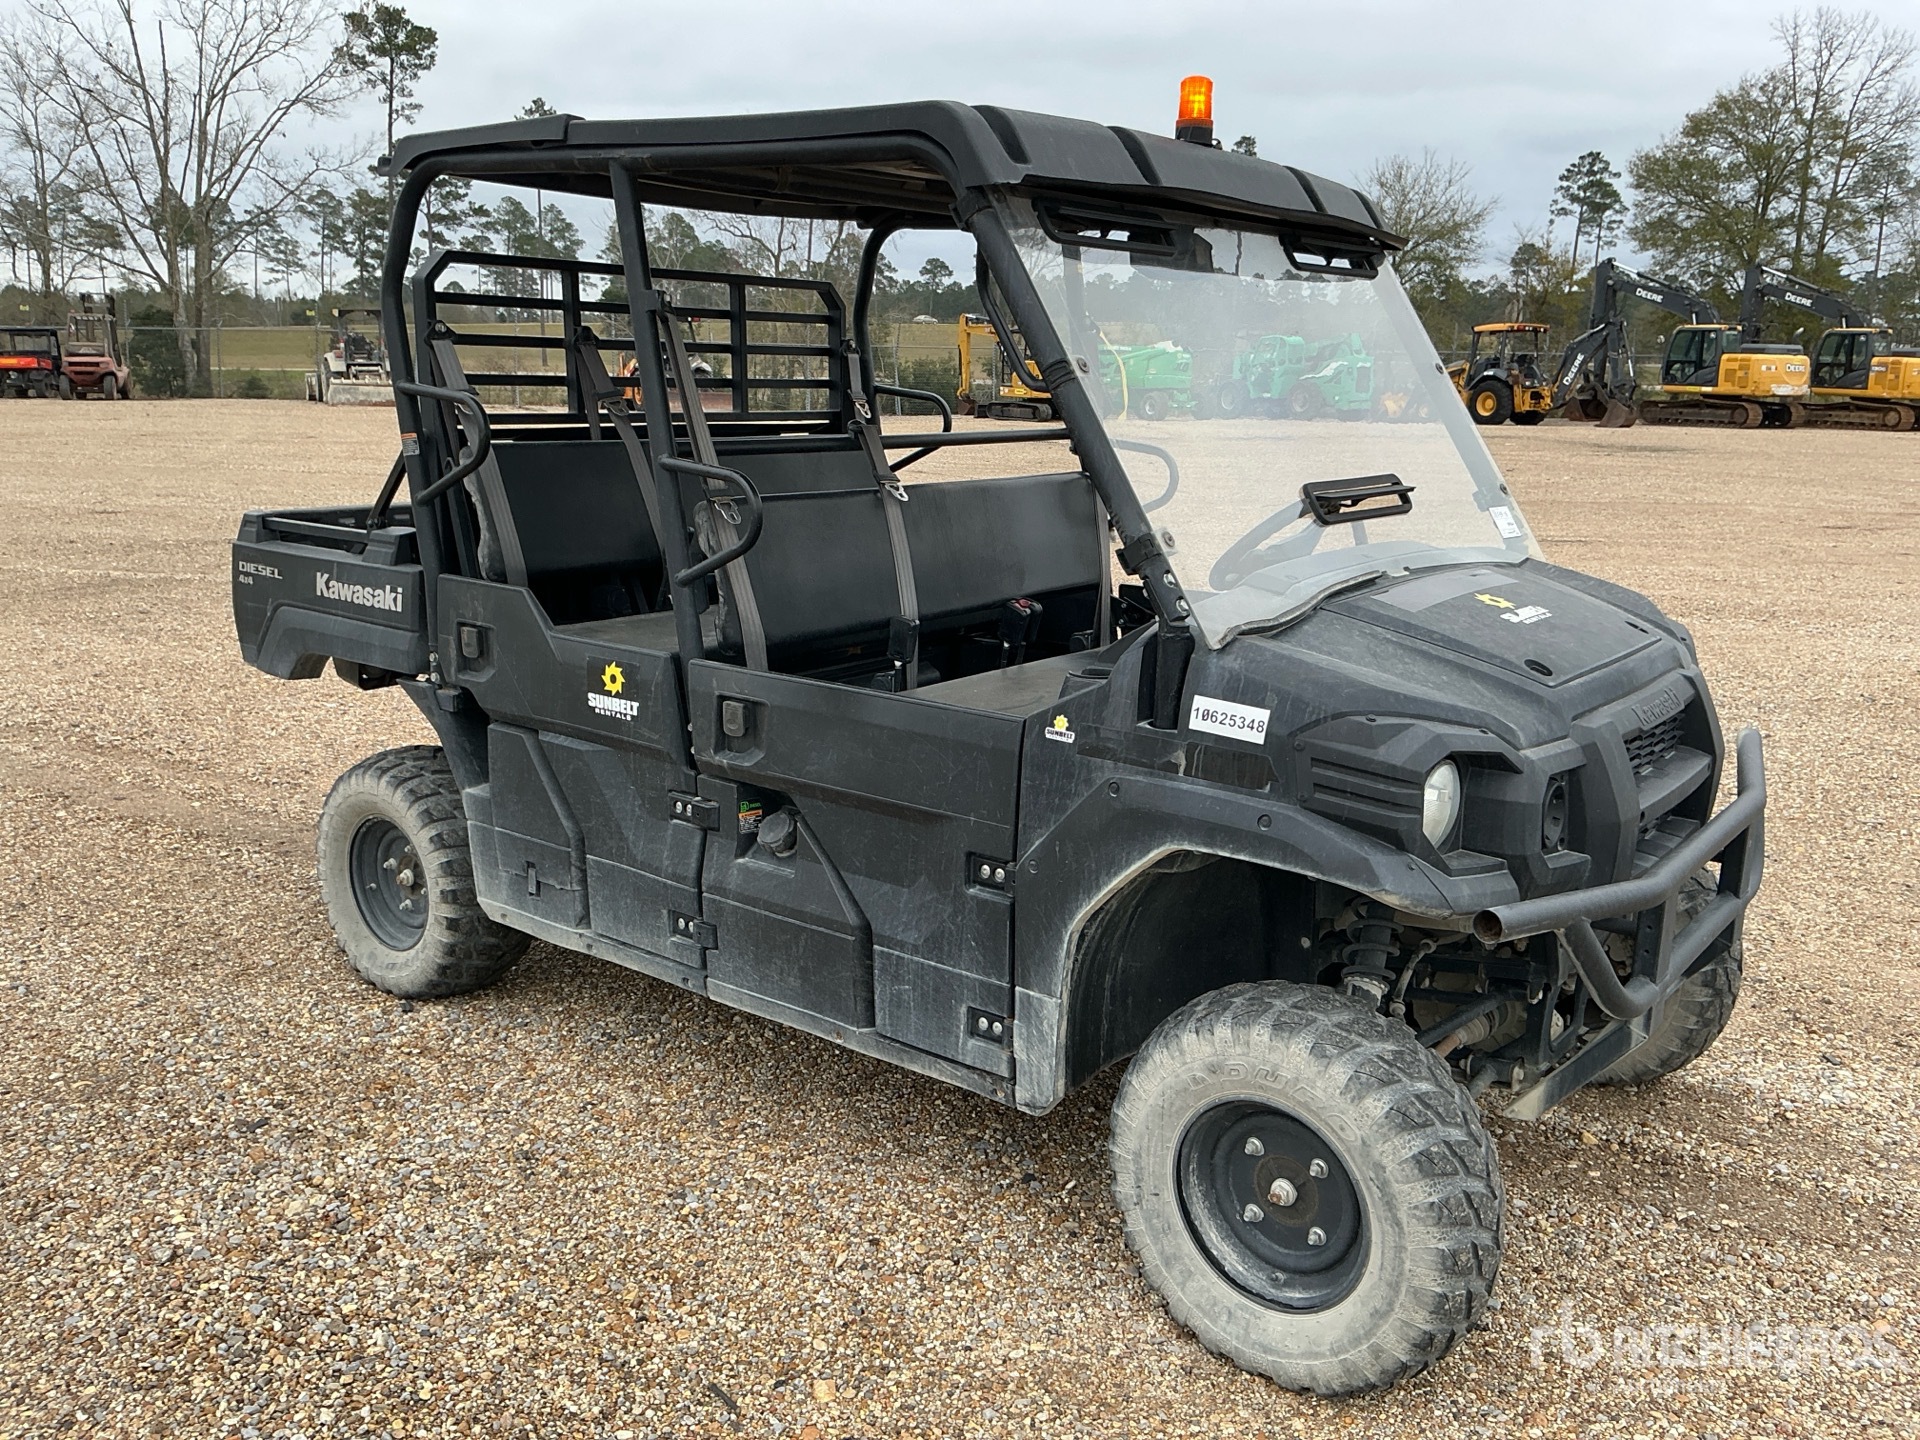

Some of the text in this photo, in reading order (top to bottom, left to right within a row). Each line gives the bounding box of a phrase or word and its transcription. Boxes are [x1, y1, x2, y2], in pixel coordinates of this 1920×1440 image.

[1636, 288, 1664, 303] DEERE
[1785, 292, 1813, 307] DEERE
[1563, 353, 1585, 385] DEERE
[238, 561, 283, 579] DIESEL
[238, 574, 254, 585] 4x4
[316, 572, 403, 612] Kawasaki
[587, 692, 639, 716] SUNBELT
[1631, 687, 1682, 727] Kawasaki
[594, 708, 632, 721] RENTALS
[1193, 707, 1266, 733] 10625348
[1046, 728, 1074, 739] SUNBELT
